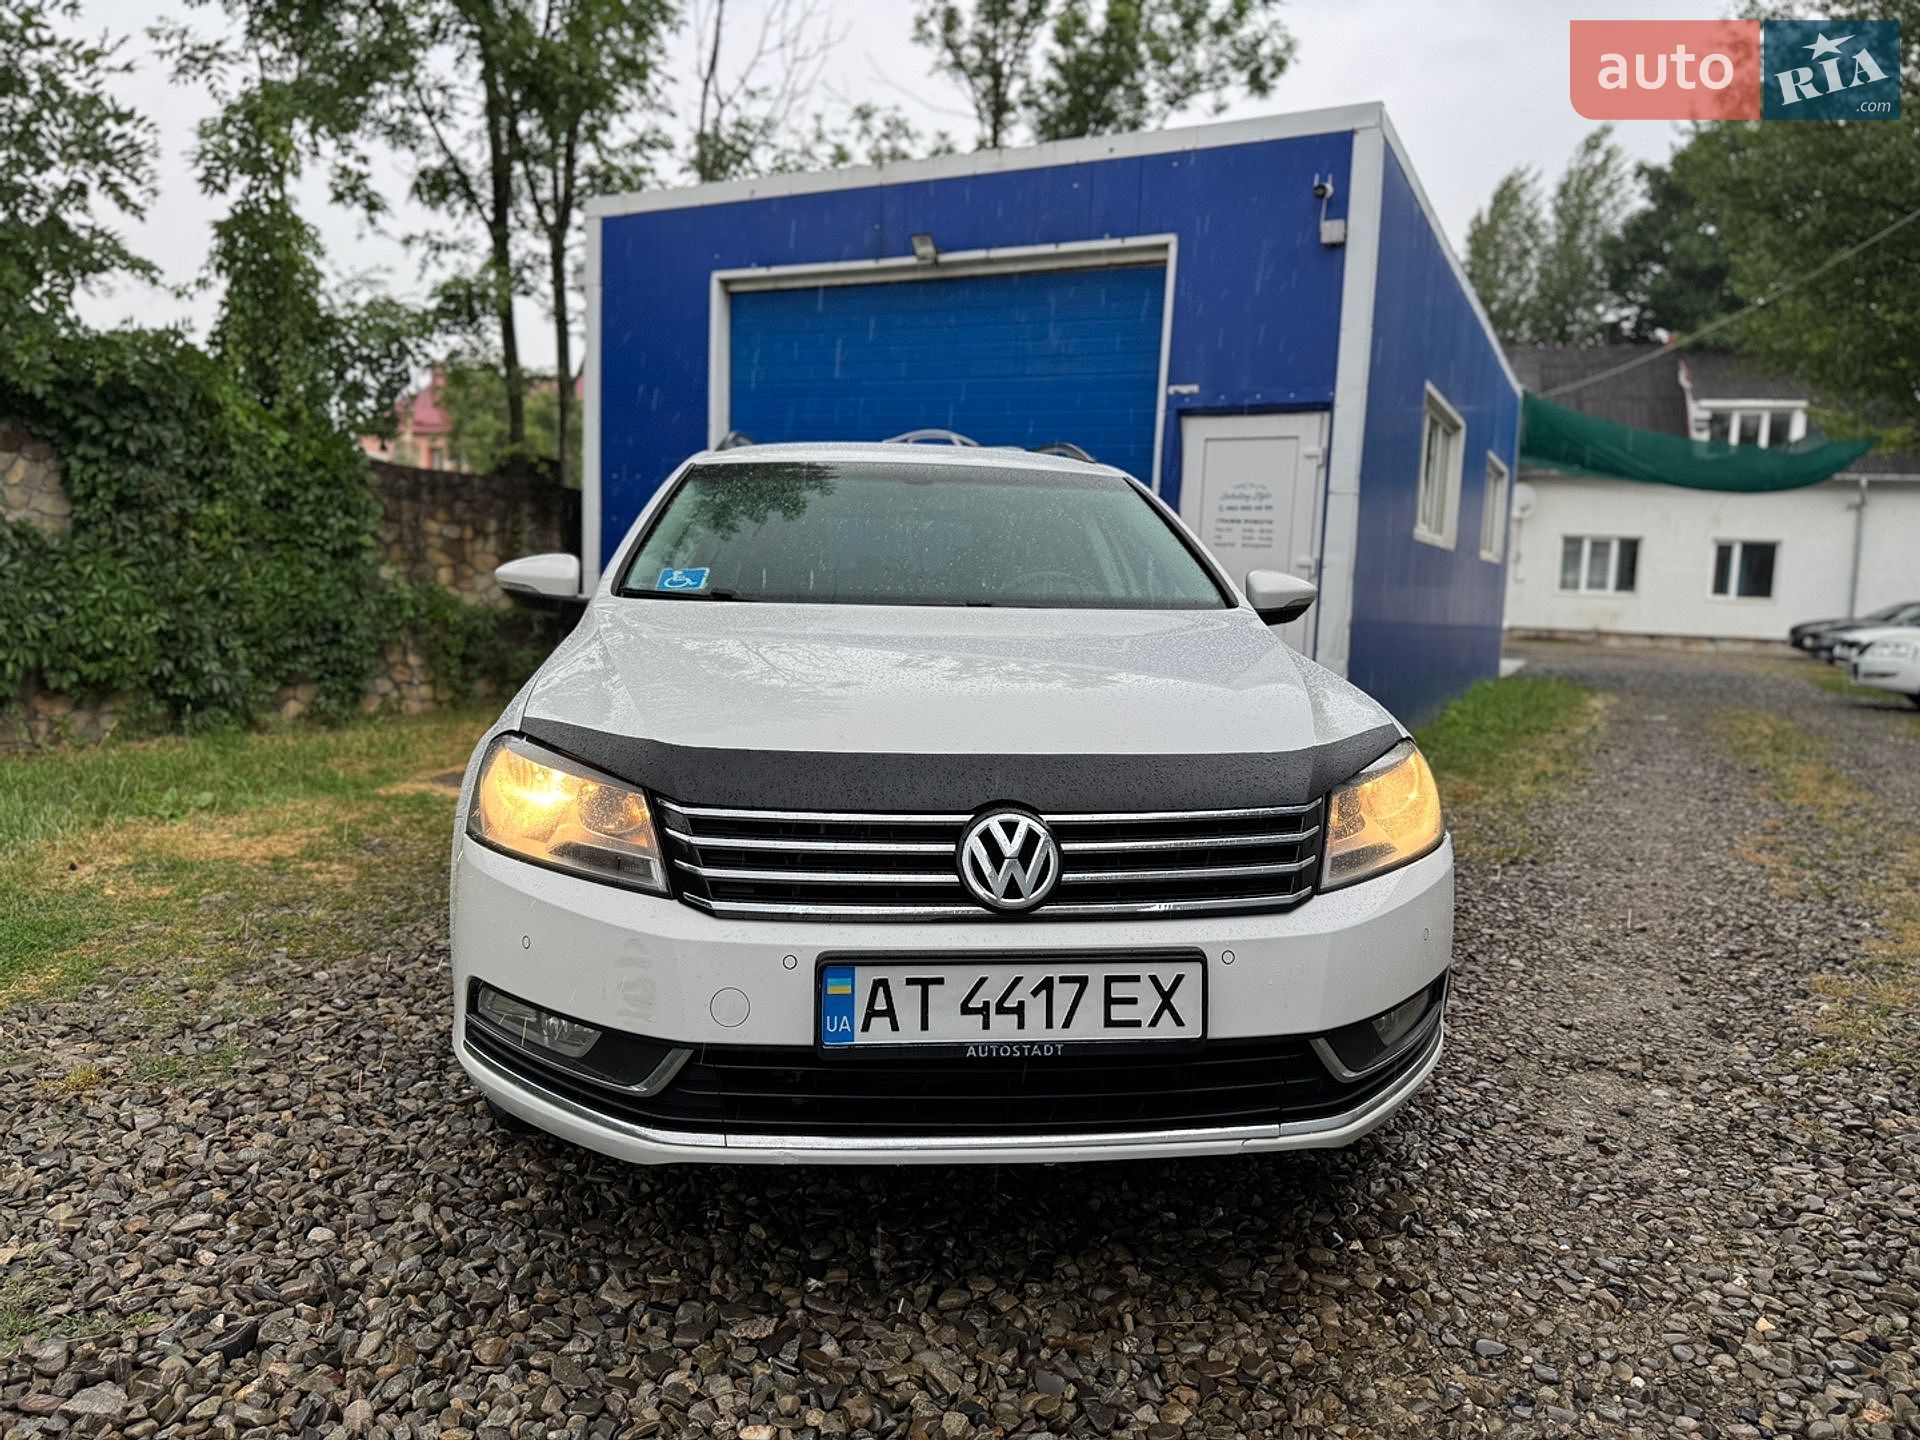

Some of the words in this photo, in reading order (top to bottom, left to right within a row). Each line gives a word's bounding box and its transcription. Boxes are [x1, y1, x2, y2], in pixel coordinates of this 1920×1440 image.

[860, 976, 945, 1033] AT
[960, 974, 1090, 1031] 4417
[1103, 973, 1186, 1029] EX
[826, 1016, 851, 1032] UA
[966, 1044, 1064, 1058] AUTOSTADT
